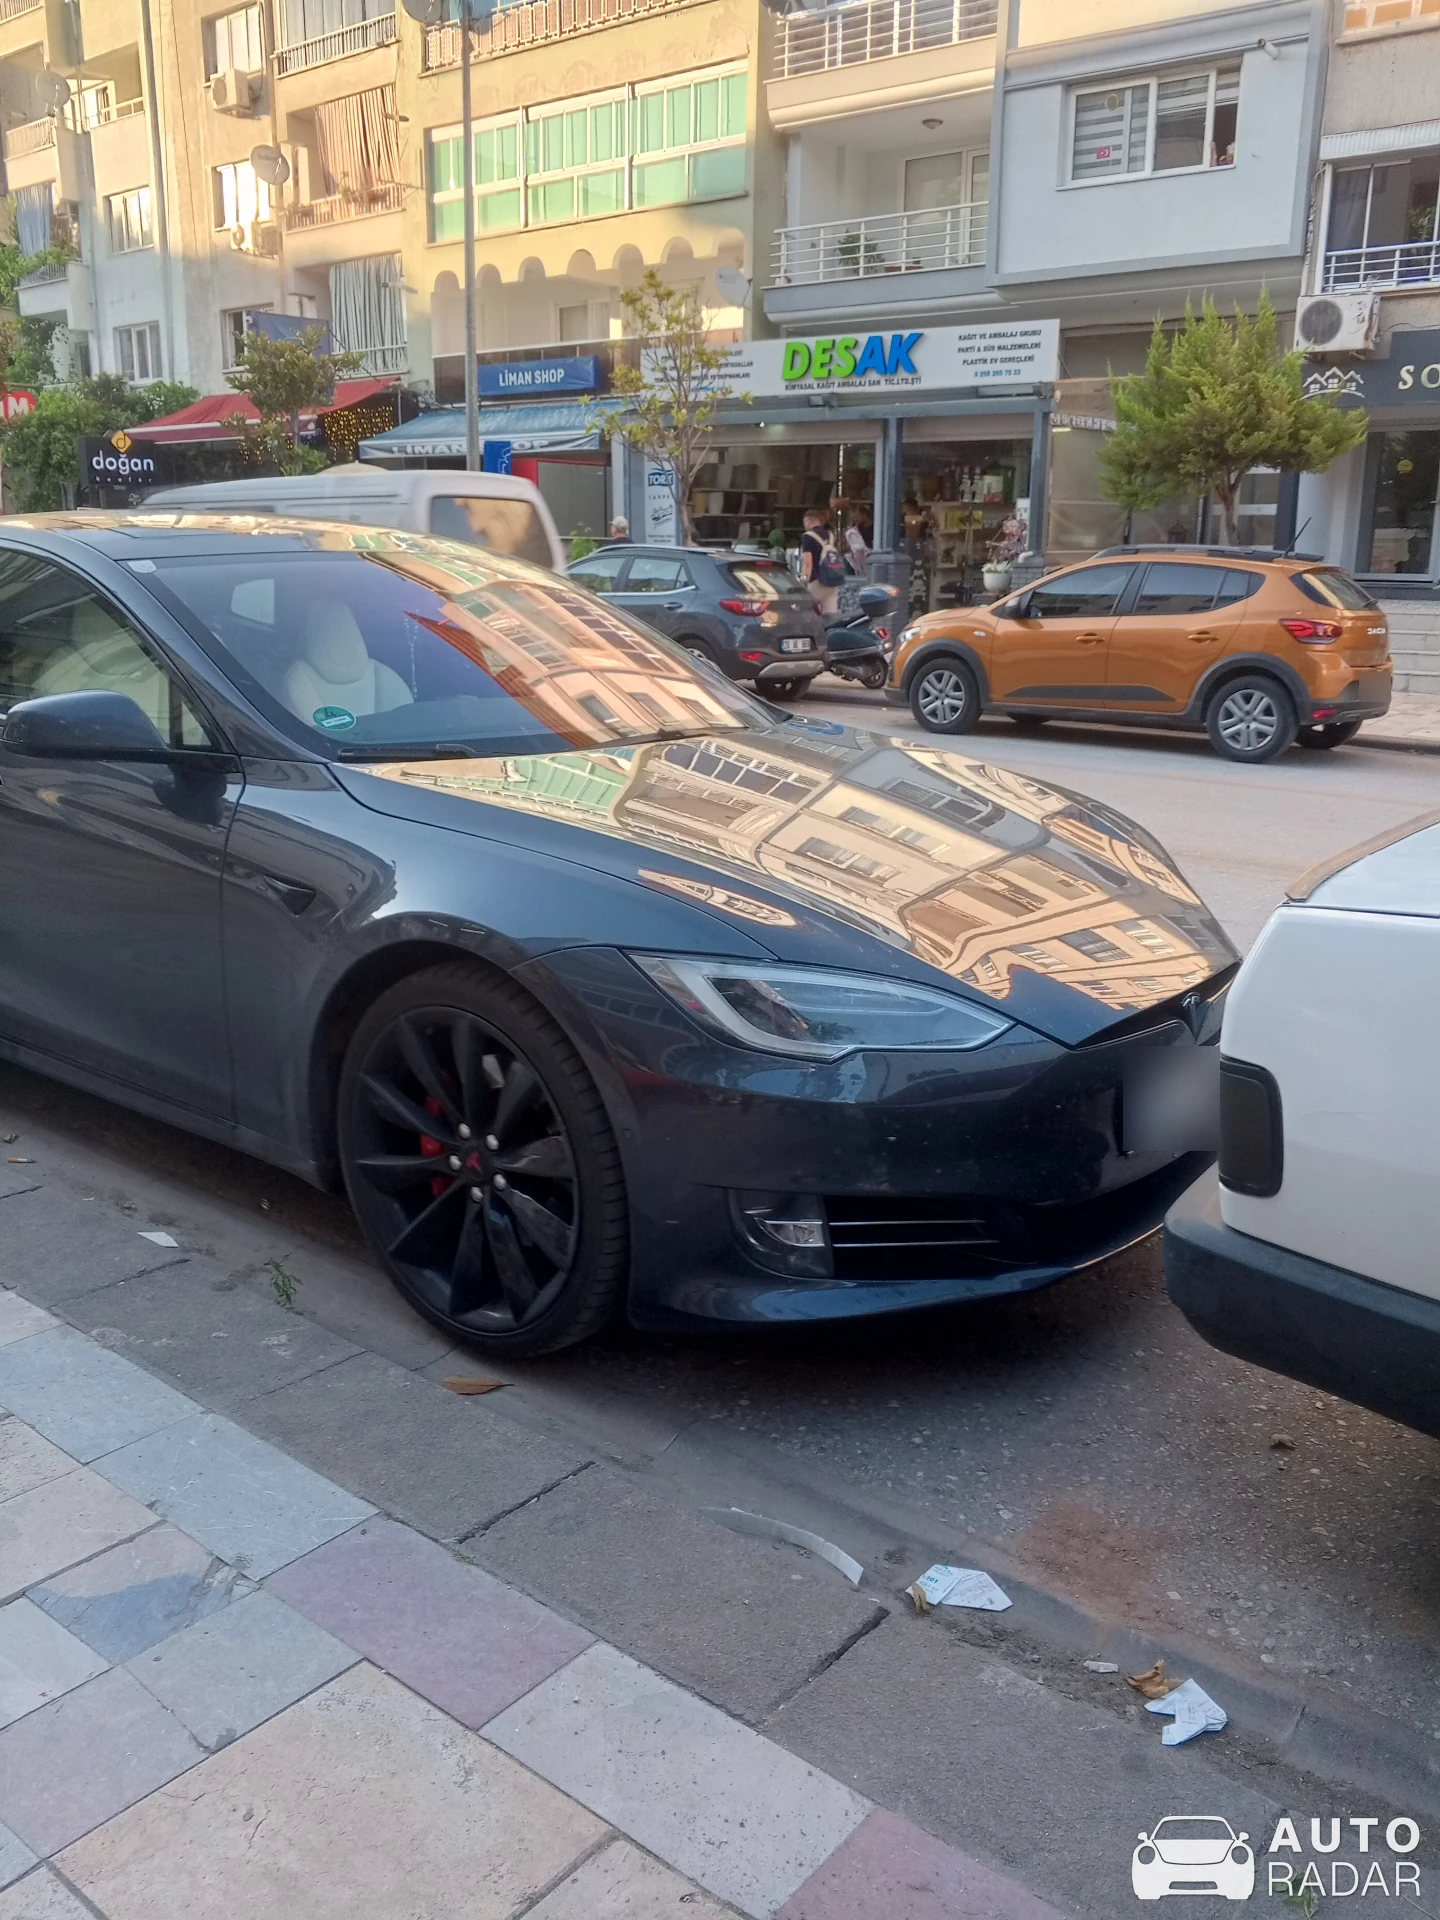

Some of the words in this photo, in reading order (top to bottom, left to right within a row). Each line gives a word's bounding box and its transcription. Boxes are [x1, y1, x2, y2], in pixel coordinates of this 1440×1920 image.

[988, 331, 1018, 340] AMBALAJ
[783, 332, 923, 381] DESAK
[962, 357, 988, 366] PLASTİK
[498, 369, 532, 387] LİMAN
[534, 368, 565, 384] SHOP
[837, 379, 866, 389] AMBALAJ
[1397, 363, 1440, 390] SO
[92, 449, 154, 475] doğan
